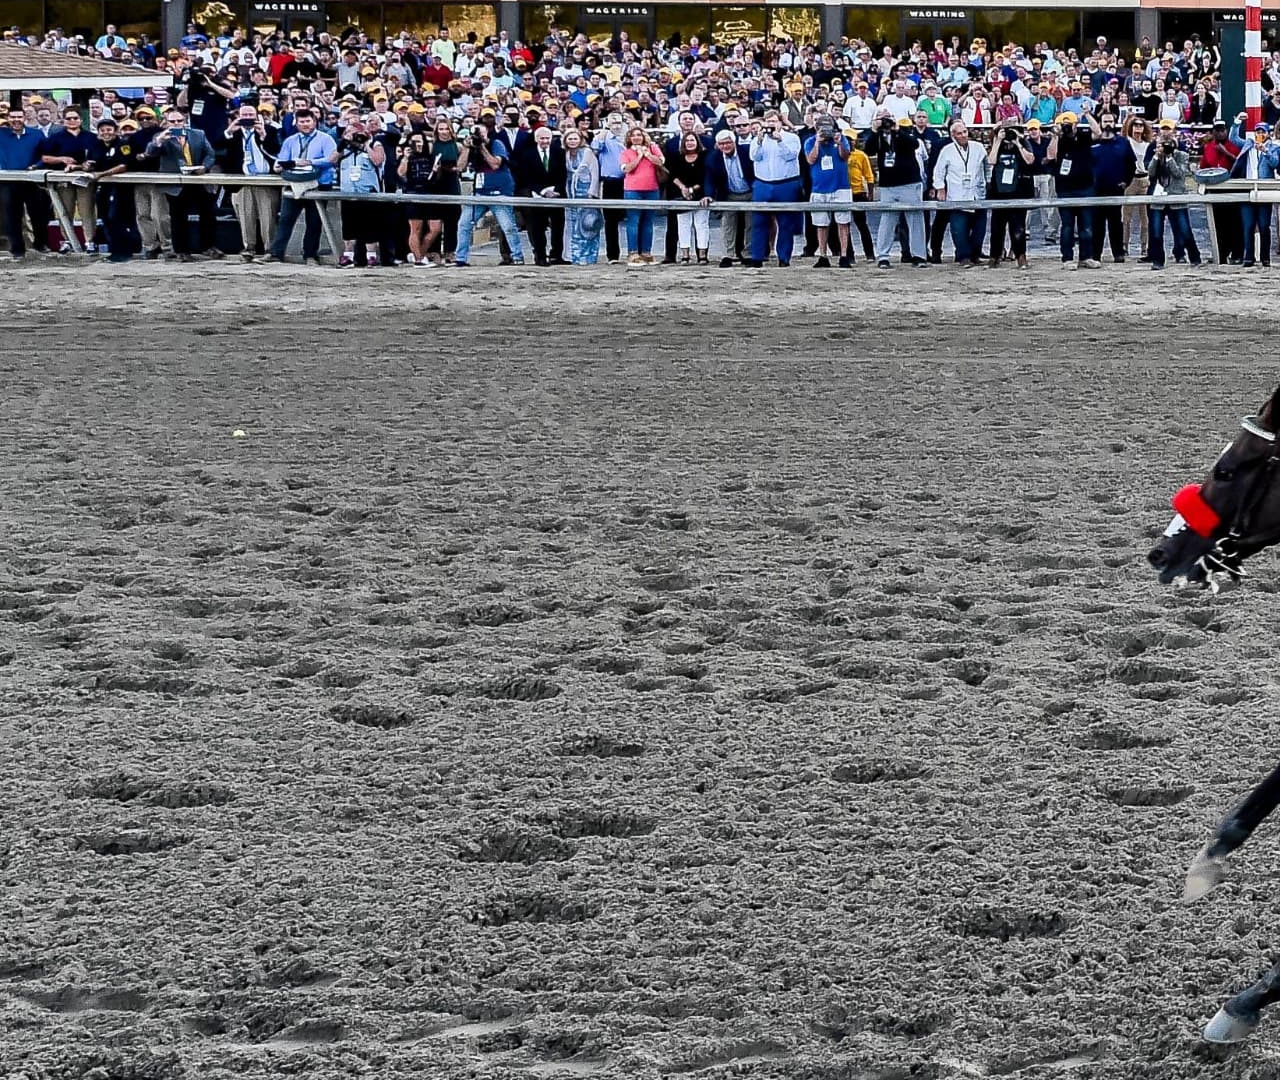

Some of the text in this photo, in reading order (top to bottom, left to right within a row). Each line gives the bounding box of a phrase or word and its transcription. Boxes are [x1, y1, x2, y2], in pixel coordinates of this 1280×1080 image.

[254, 3, 318, 11] WAGERING
[586, 7, 648, 15] WAGERING
[909, 10, 966, 18] WAGERING
